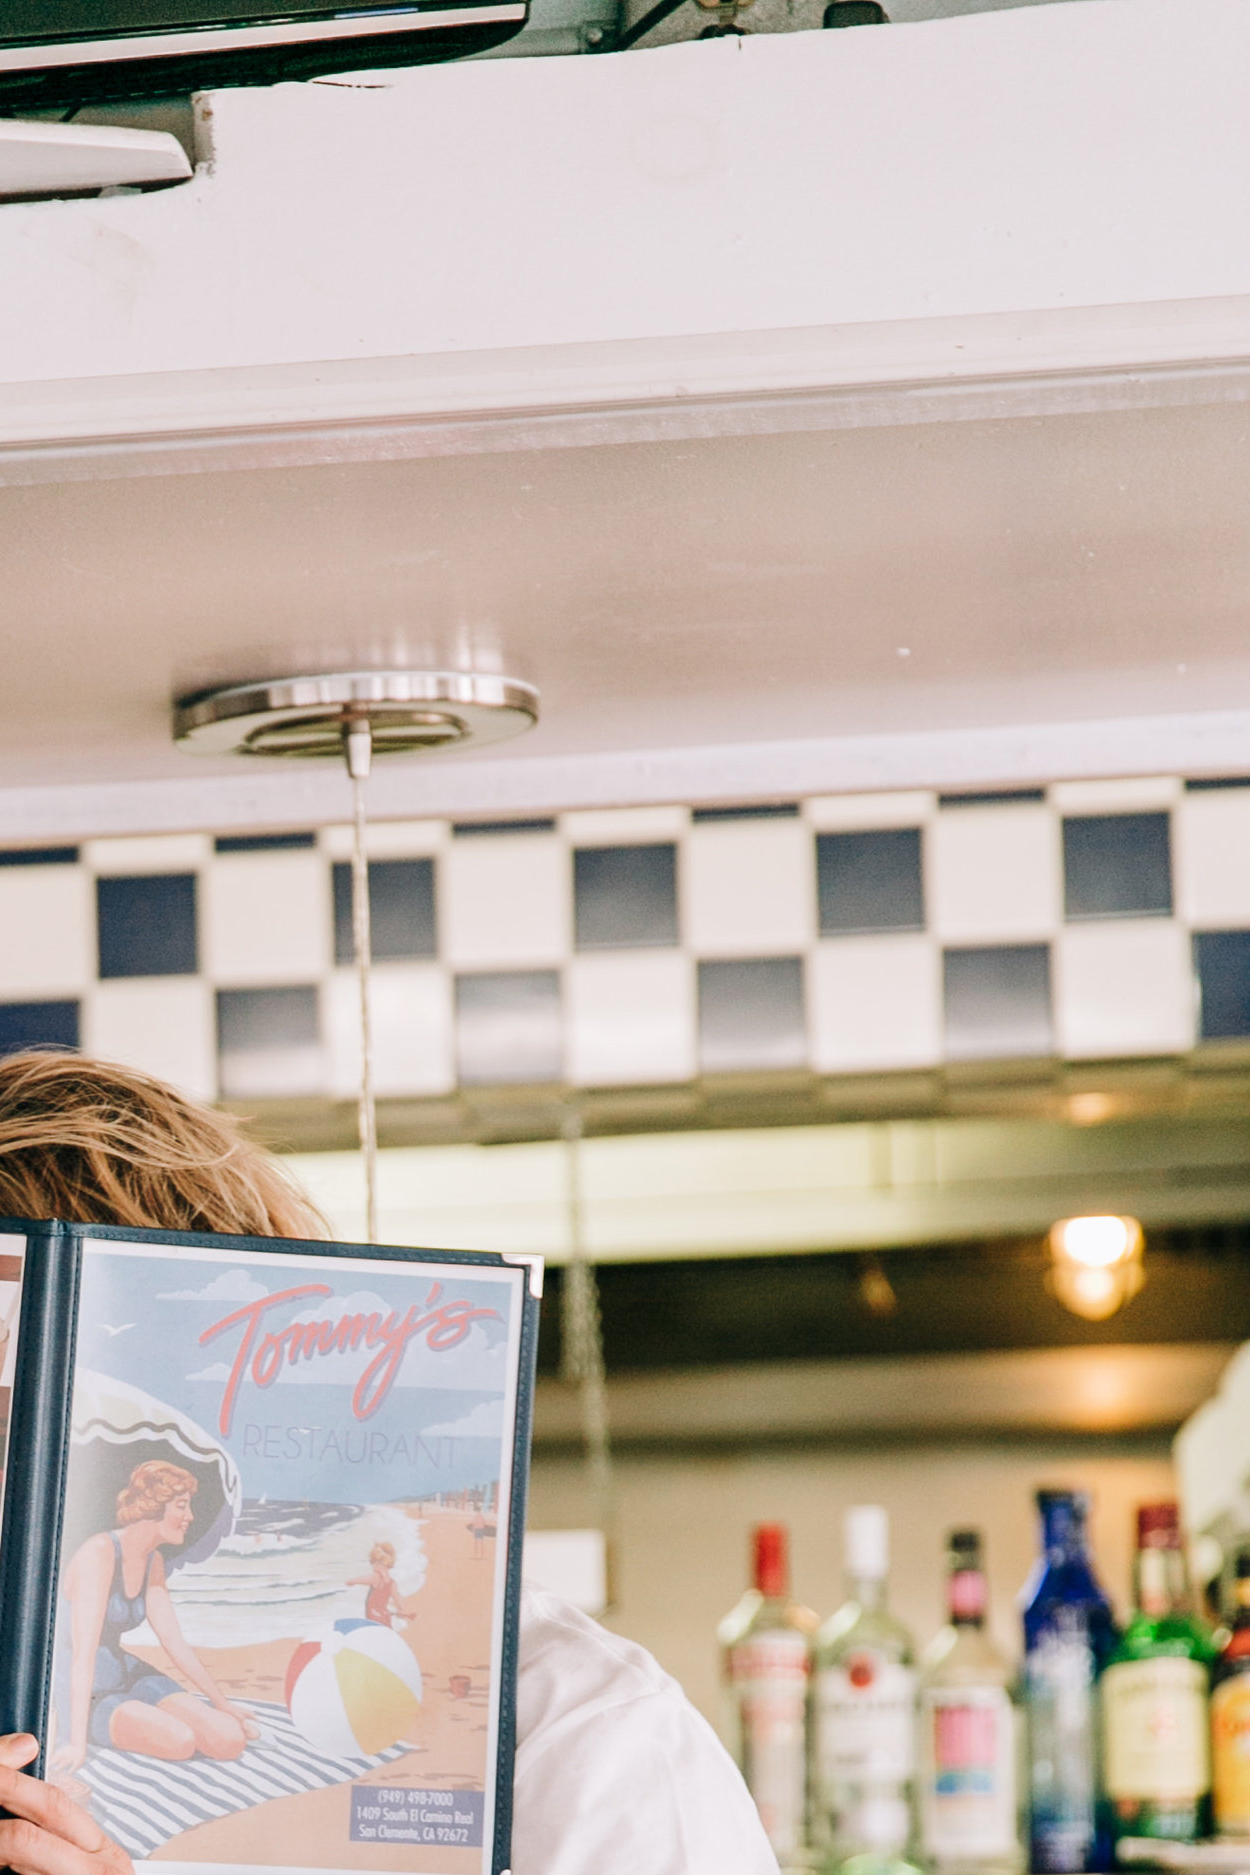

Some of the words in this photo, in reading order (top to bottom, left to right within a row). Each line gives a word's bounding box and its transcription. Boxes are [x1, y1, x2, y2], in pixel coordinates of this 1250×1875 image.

[199, 1281, 500, 1439] Tommy's
[243, 1424, 462, 1469] RESTAURANT
[378, 1789, 405, 1804] (949)
[357, 1806, 381, 1820] 1409
[382, 1808, 408, 1821] South
[410, 1809, 418, 1821] El
[420, 1810, 452, 1823] Camino
[454, 1811, 474, 1825] Real
[359, 1824, 375, 1837] San
[378, 1825, 421, 1841] Clemente,
[423, 1828, 435, 1840] CA
[437, 1828, 468, 1842] 92672
